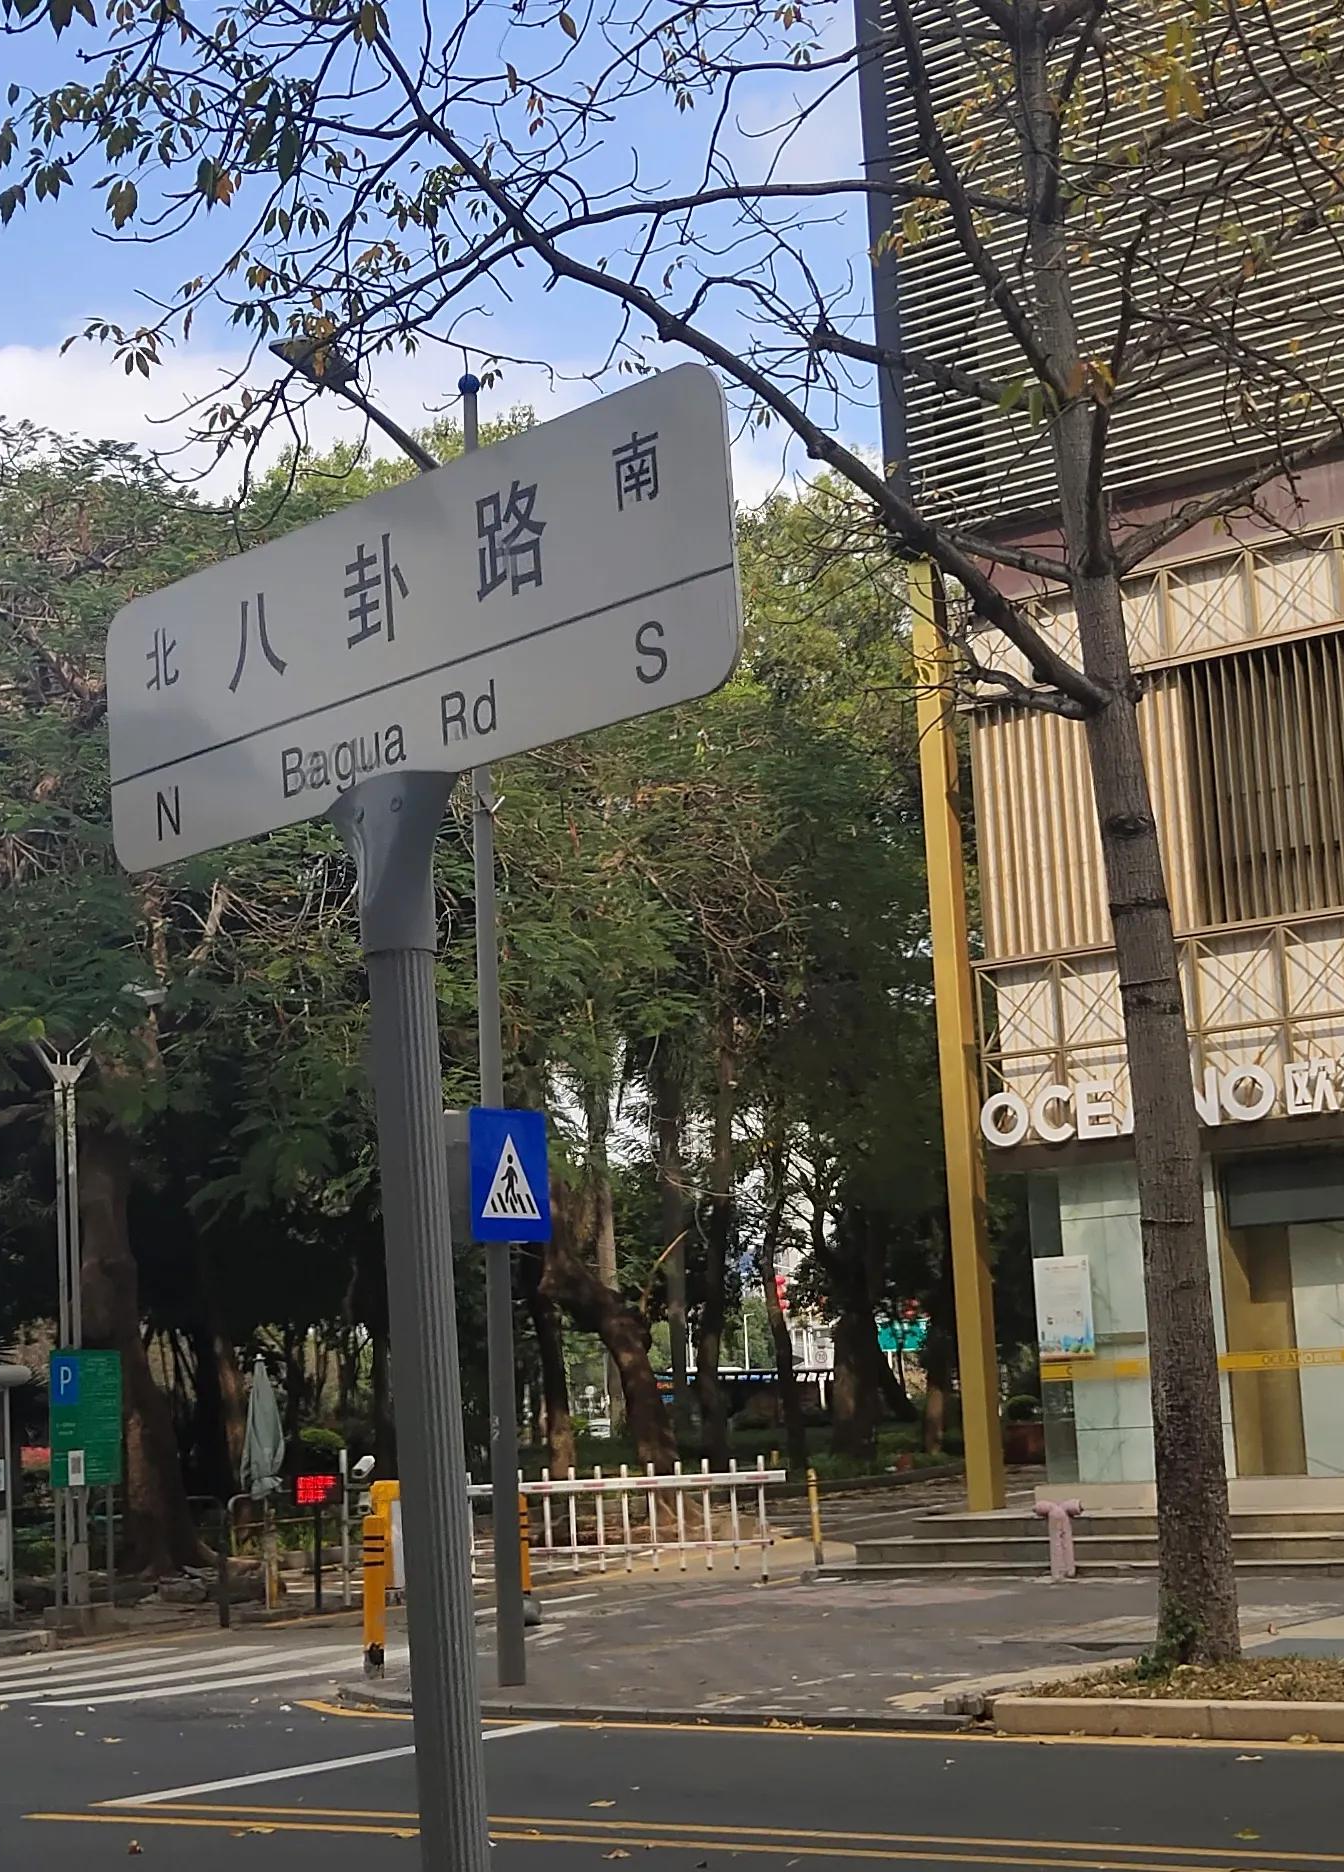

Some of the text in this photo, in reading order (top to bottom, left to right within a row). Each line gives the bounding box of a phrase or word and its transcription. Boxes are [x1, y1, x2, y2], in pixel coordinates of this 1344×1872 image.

[146, 431, 659, 693] 北 八卦路 南
[156, 621, 668, 841] N Bagua Rd S
[981, 1055, 1275, 1147] OCENO
[60, 1366, 72, 1395] P
